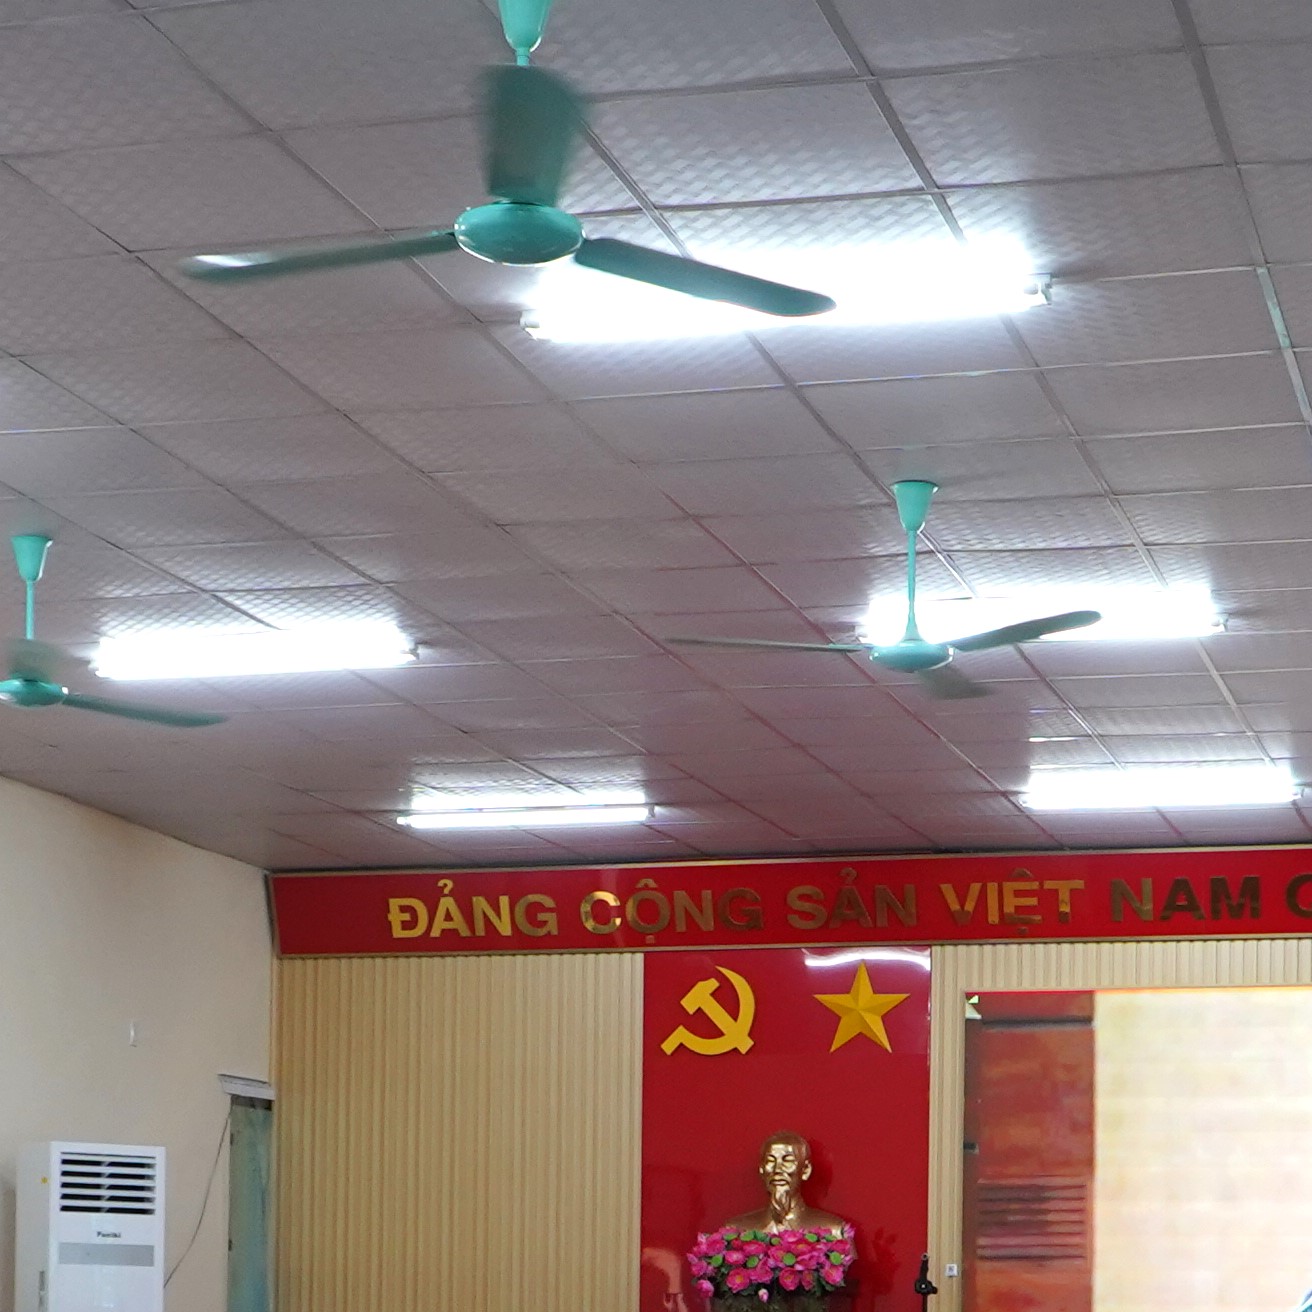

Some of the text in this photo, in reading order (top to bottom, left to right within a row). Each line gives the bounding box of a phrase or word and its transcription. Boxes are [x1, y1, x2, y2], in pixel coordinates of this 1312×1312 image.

[387, 878, 559, 939] ĐẢNG
[579, 878, 765, 944] CỘNG
[786, 867, 919, 931] SẢN
[939, 868, 1085, 935] VIỆT
[1110, 875, 1262, 923] NAM
